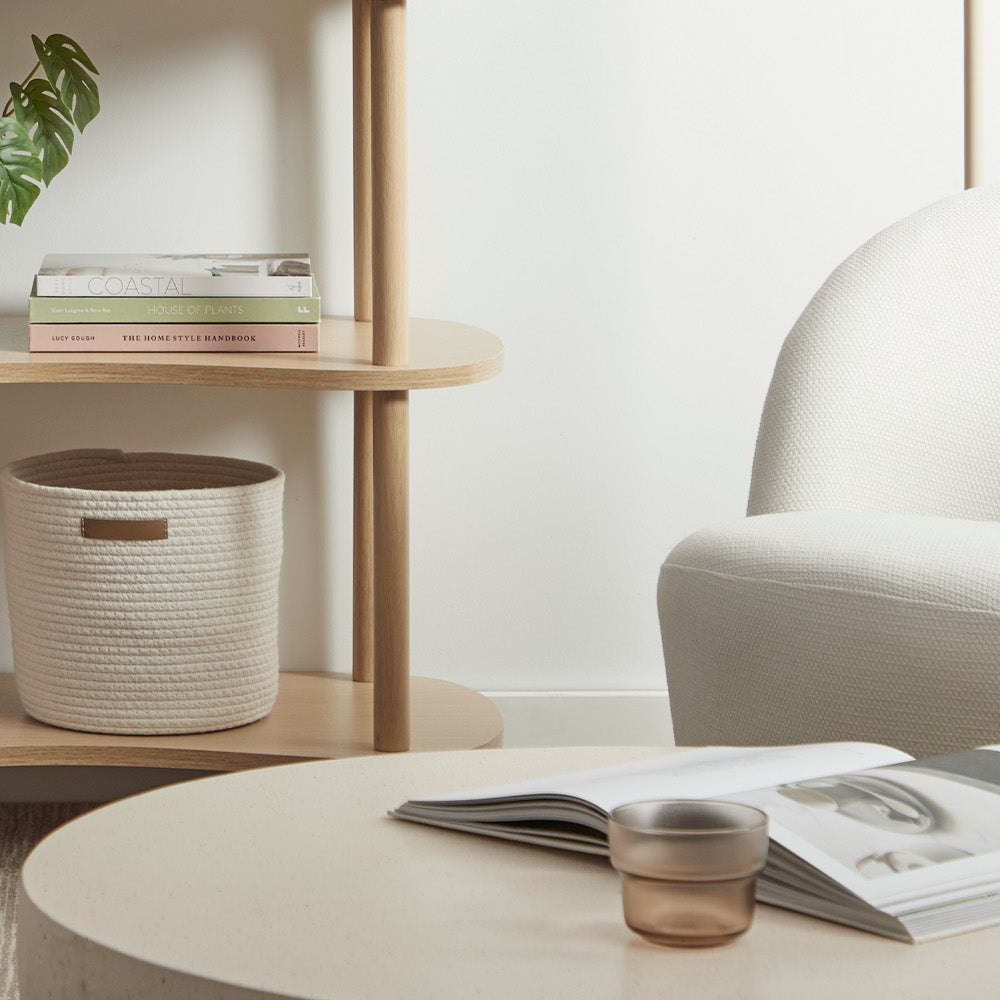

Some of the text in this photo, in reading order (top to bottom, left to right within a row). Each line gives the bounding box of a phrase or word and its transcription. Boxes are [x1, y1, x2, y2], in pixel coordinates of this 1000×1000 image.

[87, 276, 192, 295] COASTAL
[147, 305, 244, 315] HOUSE OF PLANTS
